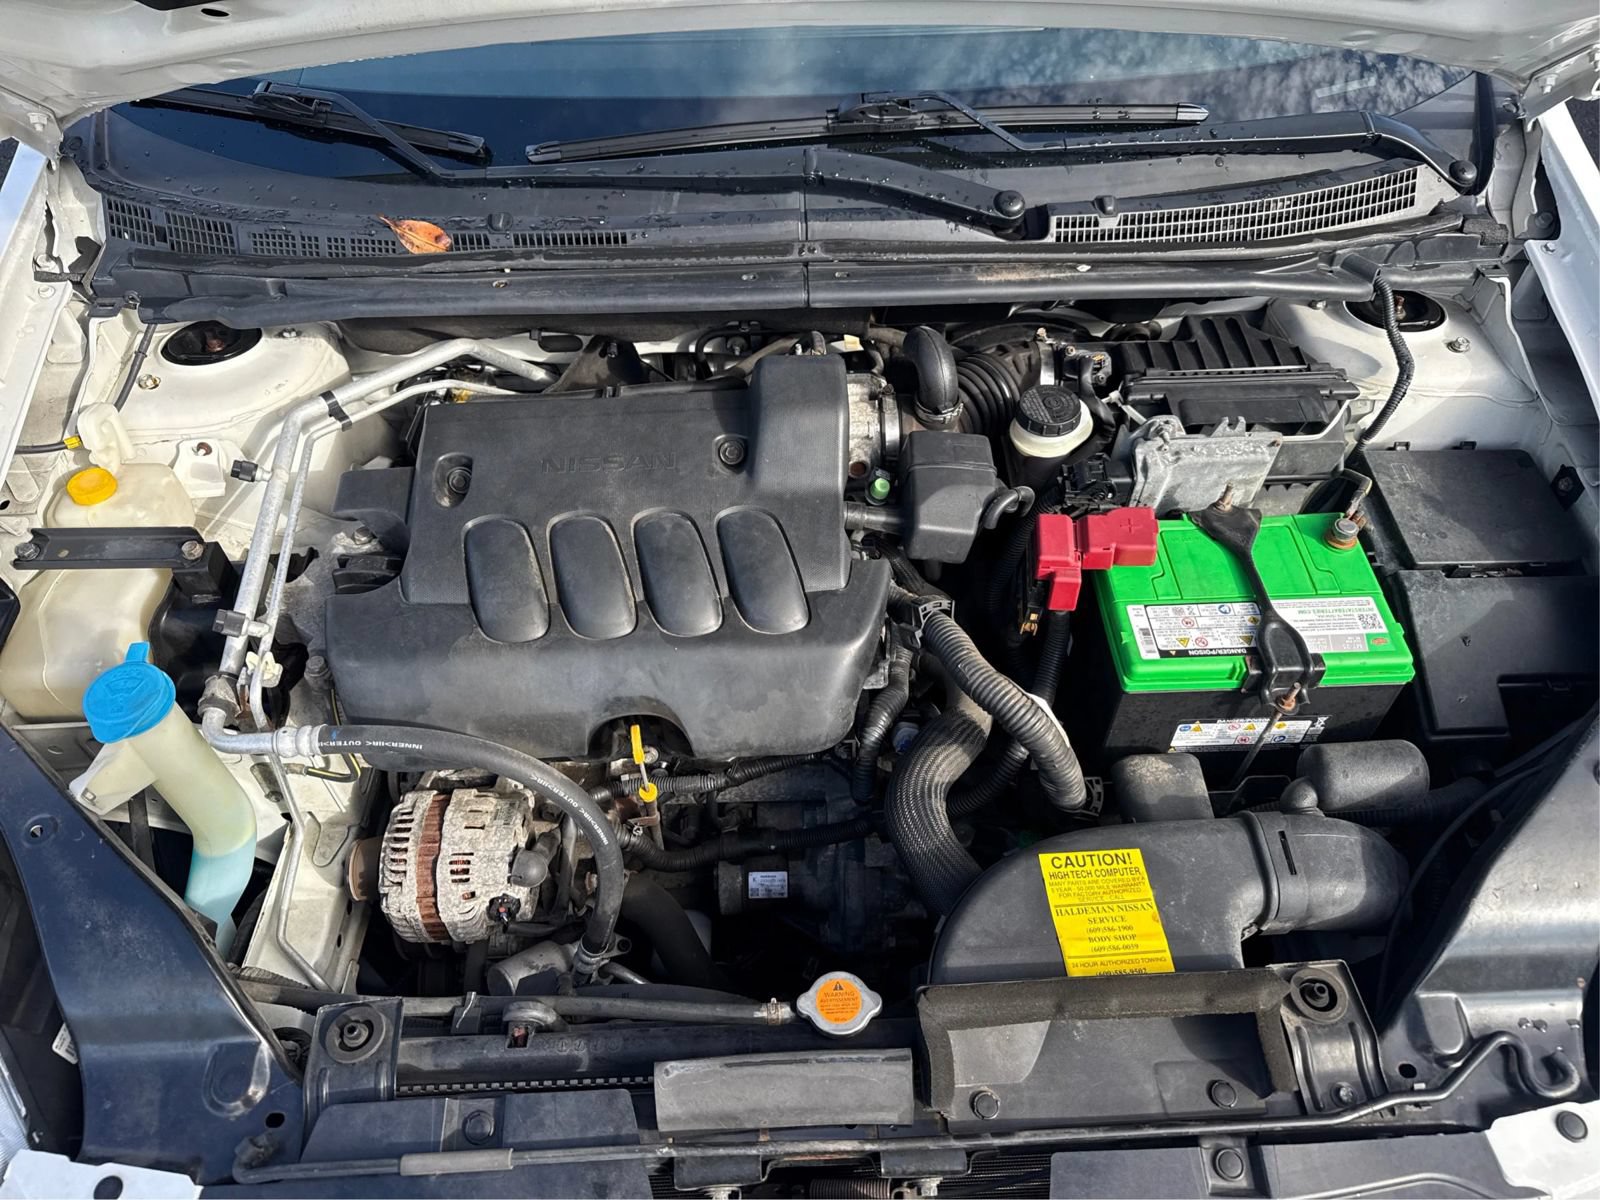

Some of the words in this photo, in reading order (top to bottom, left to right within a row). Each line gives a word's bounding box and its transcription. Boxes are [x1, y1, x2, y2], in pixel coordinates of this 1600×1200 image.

[540, 452, 676, 473] NISSAN
[1188, 648, 1247, 656] DANGER/POISON
[1051, 852, 1132, 869] CAUTION!
[1049, 871, 1070, 880] HIGH
[1070, 870, 1092, 879] TECH
[1094, 866, 1140, 878] COMPUTER
[1102, 888, 1141, 896] AUTHORIZED
[1056, 904, 1114, 916] HALDEMAN
[1117, 902, 1154, 912] NISSAN
[1088, 915, 1126, 925] SERVICE
[1088, 935, 1110, 943] BODY
[1114, 934, 1136, 942] SHOP
[1100, 958, 1140, 968] AUTHORIZED
[1141, 956, 1167, 964] TOWING
